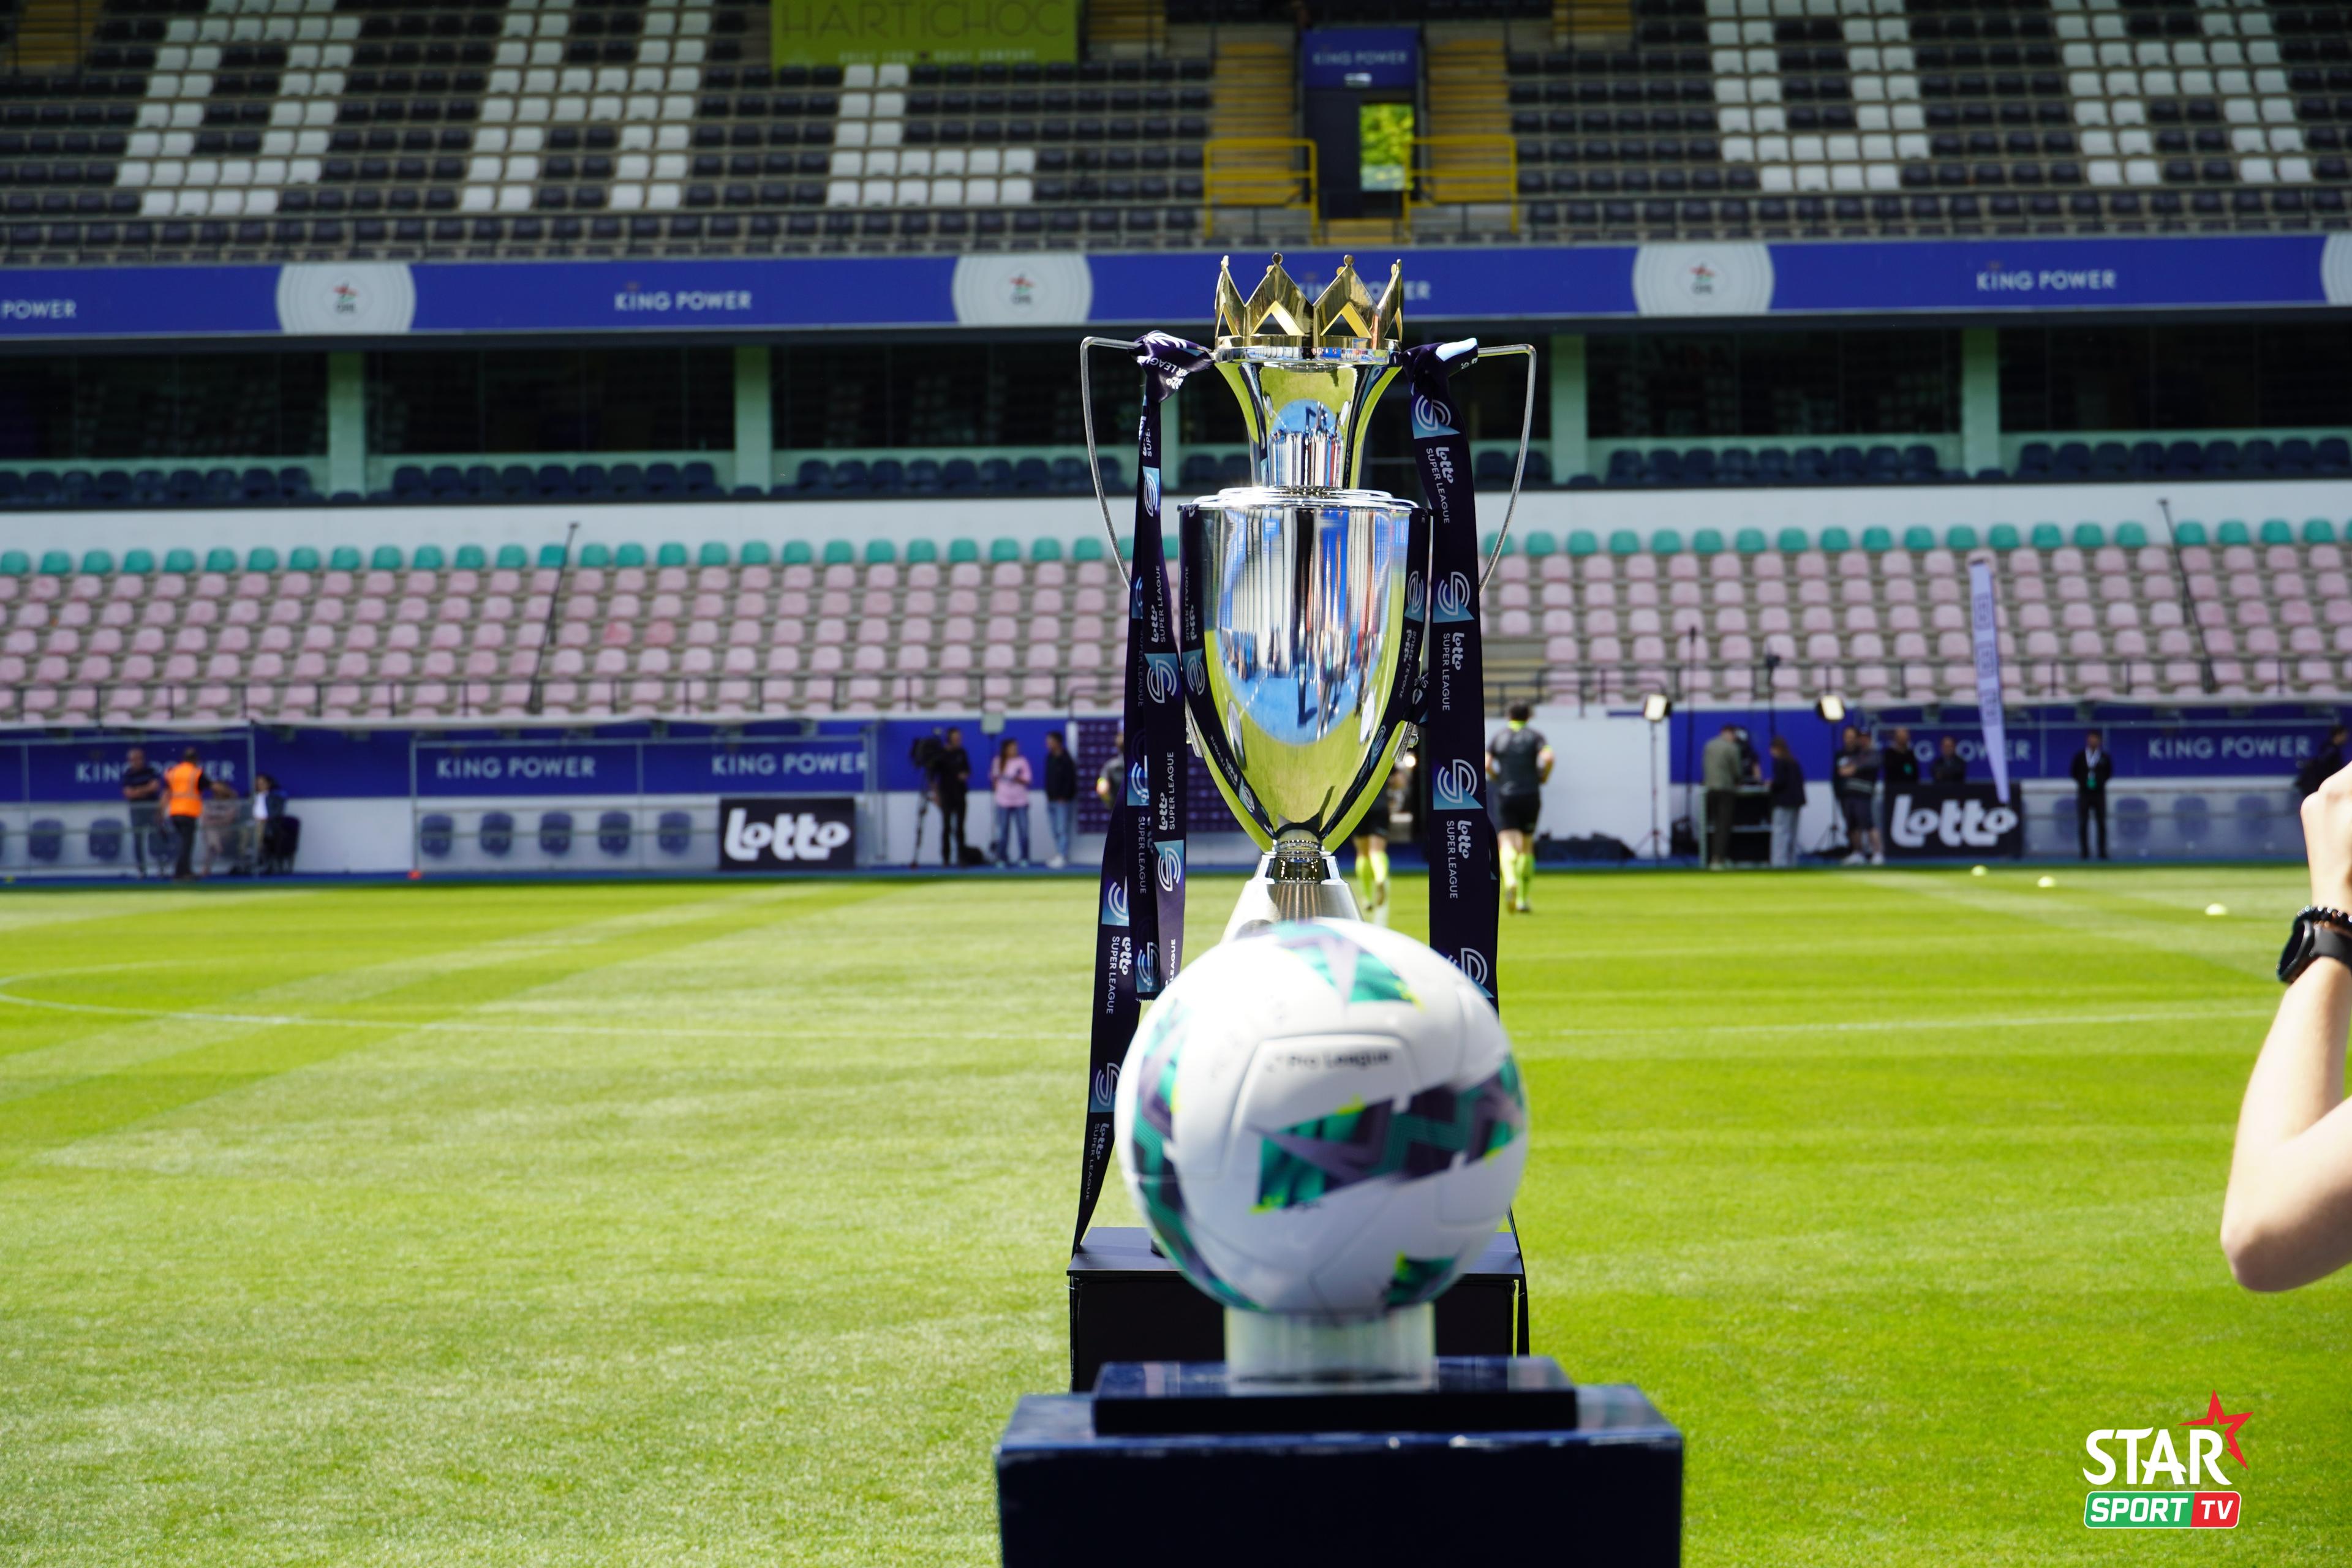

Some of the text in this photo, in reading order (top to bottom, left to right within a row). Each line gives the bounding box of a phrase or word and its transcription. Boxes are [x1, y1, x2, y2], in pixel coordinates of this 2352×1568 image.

[1977, 270, 2116, 290] KING POWER
[1, 300, 77, 318] POWER
[614, 291, 752, 311] KING POWER
[1426, 448, 1450, 523] SUPER LEAGUE
[1156, 565, 1164, 606] LEAGUE
[1442, 669, 1450, 710] LEAGUE
[712, 752, 777, 775] KING
[2148, 736, 2312, 760] KING POWER
[436, 755, 596, 779] KING POWER
[1447, 821, 1458, 899] SUPER LEAGUE
[1106, 937, 1120, 1014] SUPER LEAGUE
[1085, 1123, 1100, 1201] SUPER LEAGUE
